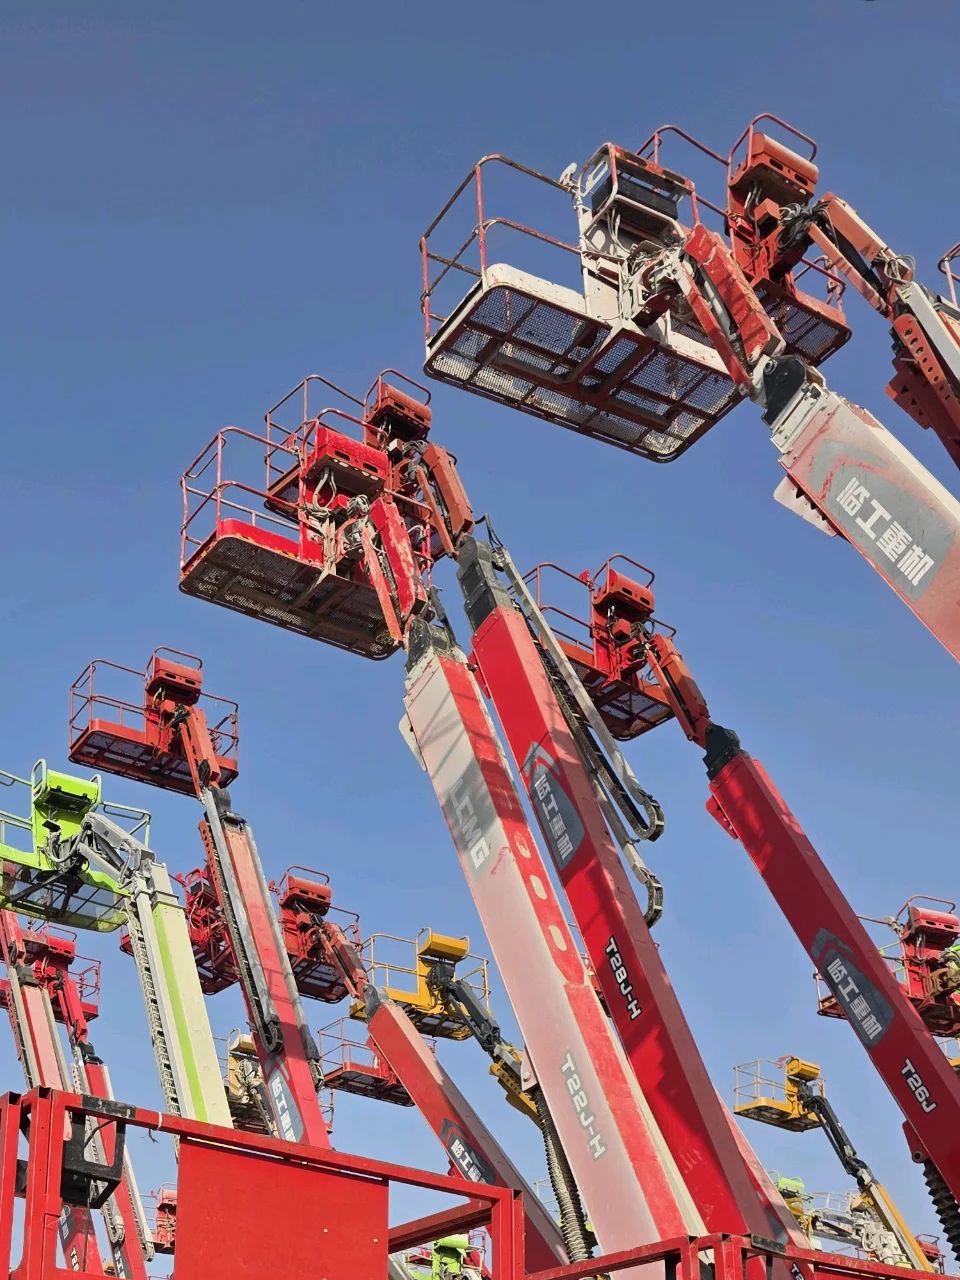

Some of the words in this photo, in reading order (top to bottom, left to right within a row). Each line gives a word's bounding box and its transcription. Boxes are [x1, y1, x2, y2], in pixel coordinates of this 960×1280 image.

[835, 477, 935, 586] 临工重机
[605, 937, 642, 1021] T28J-H
[827, 958, 883, 1040] 临工重机
[901, 1058, 937, 1114] T26J
[451, 1139, 487, 1184] 临工重
